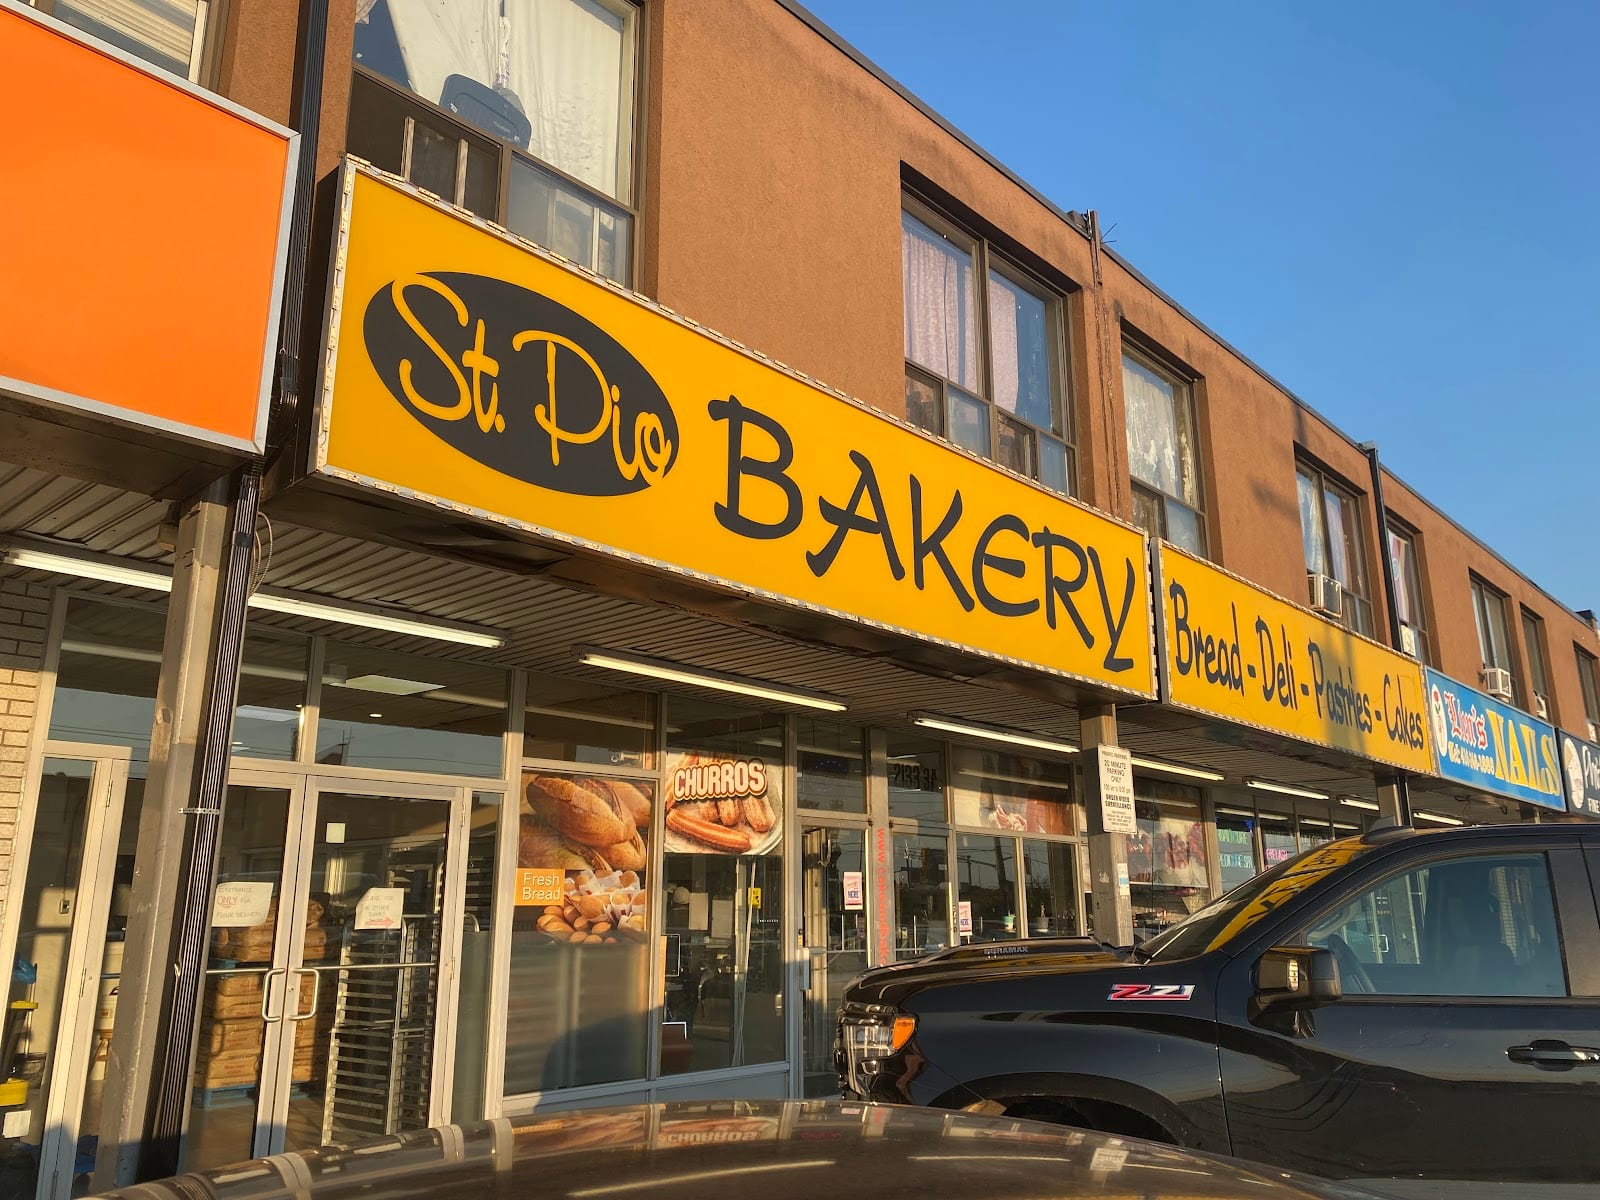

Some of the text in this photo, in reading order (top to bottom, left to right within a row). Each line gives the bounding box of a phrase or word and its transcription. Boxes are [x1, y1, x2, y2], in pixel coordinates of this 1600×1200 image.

[391, 273, 674, 483] St. Pio
[707, 394, 1136, 673] BAKERY
[1169, 577, 1245, 697] Bread
[1254, 614, 1298, 711] Deli
[1307, 637, 1373, 734] Pastries
[1383, 673, 1424, 751] Cakes
[1485, 708, 1561, 797] NAILS
[673, 759, 766, 800] CHURROS
[521, 886, 561, 901] Bread
[522, 872, 560, 886] Fresh
[983, 945, 1029, 955] DURAMAX
[1106, 983, 1196, 1001] Z71
